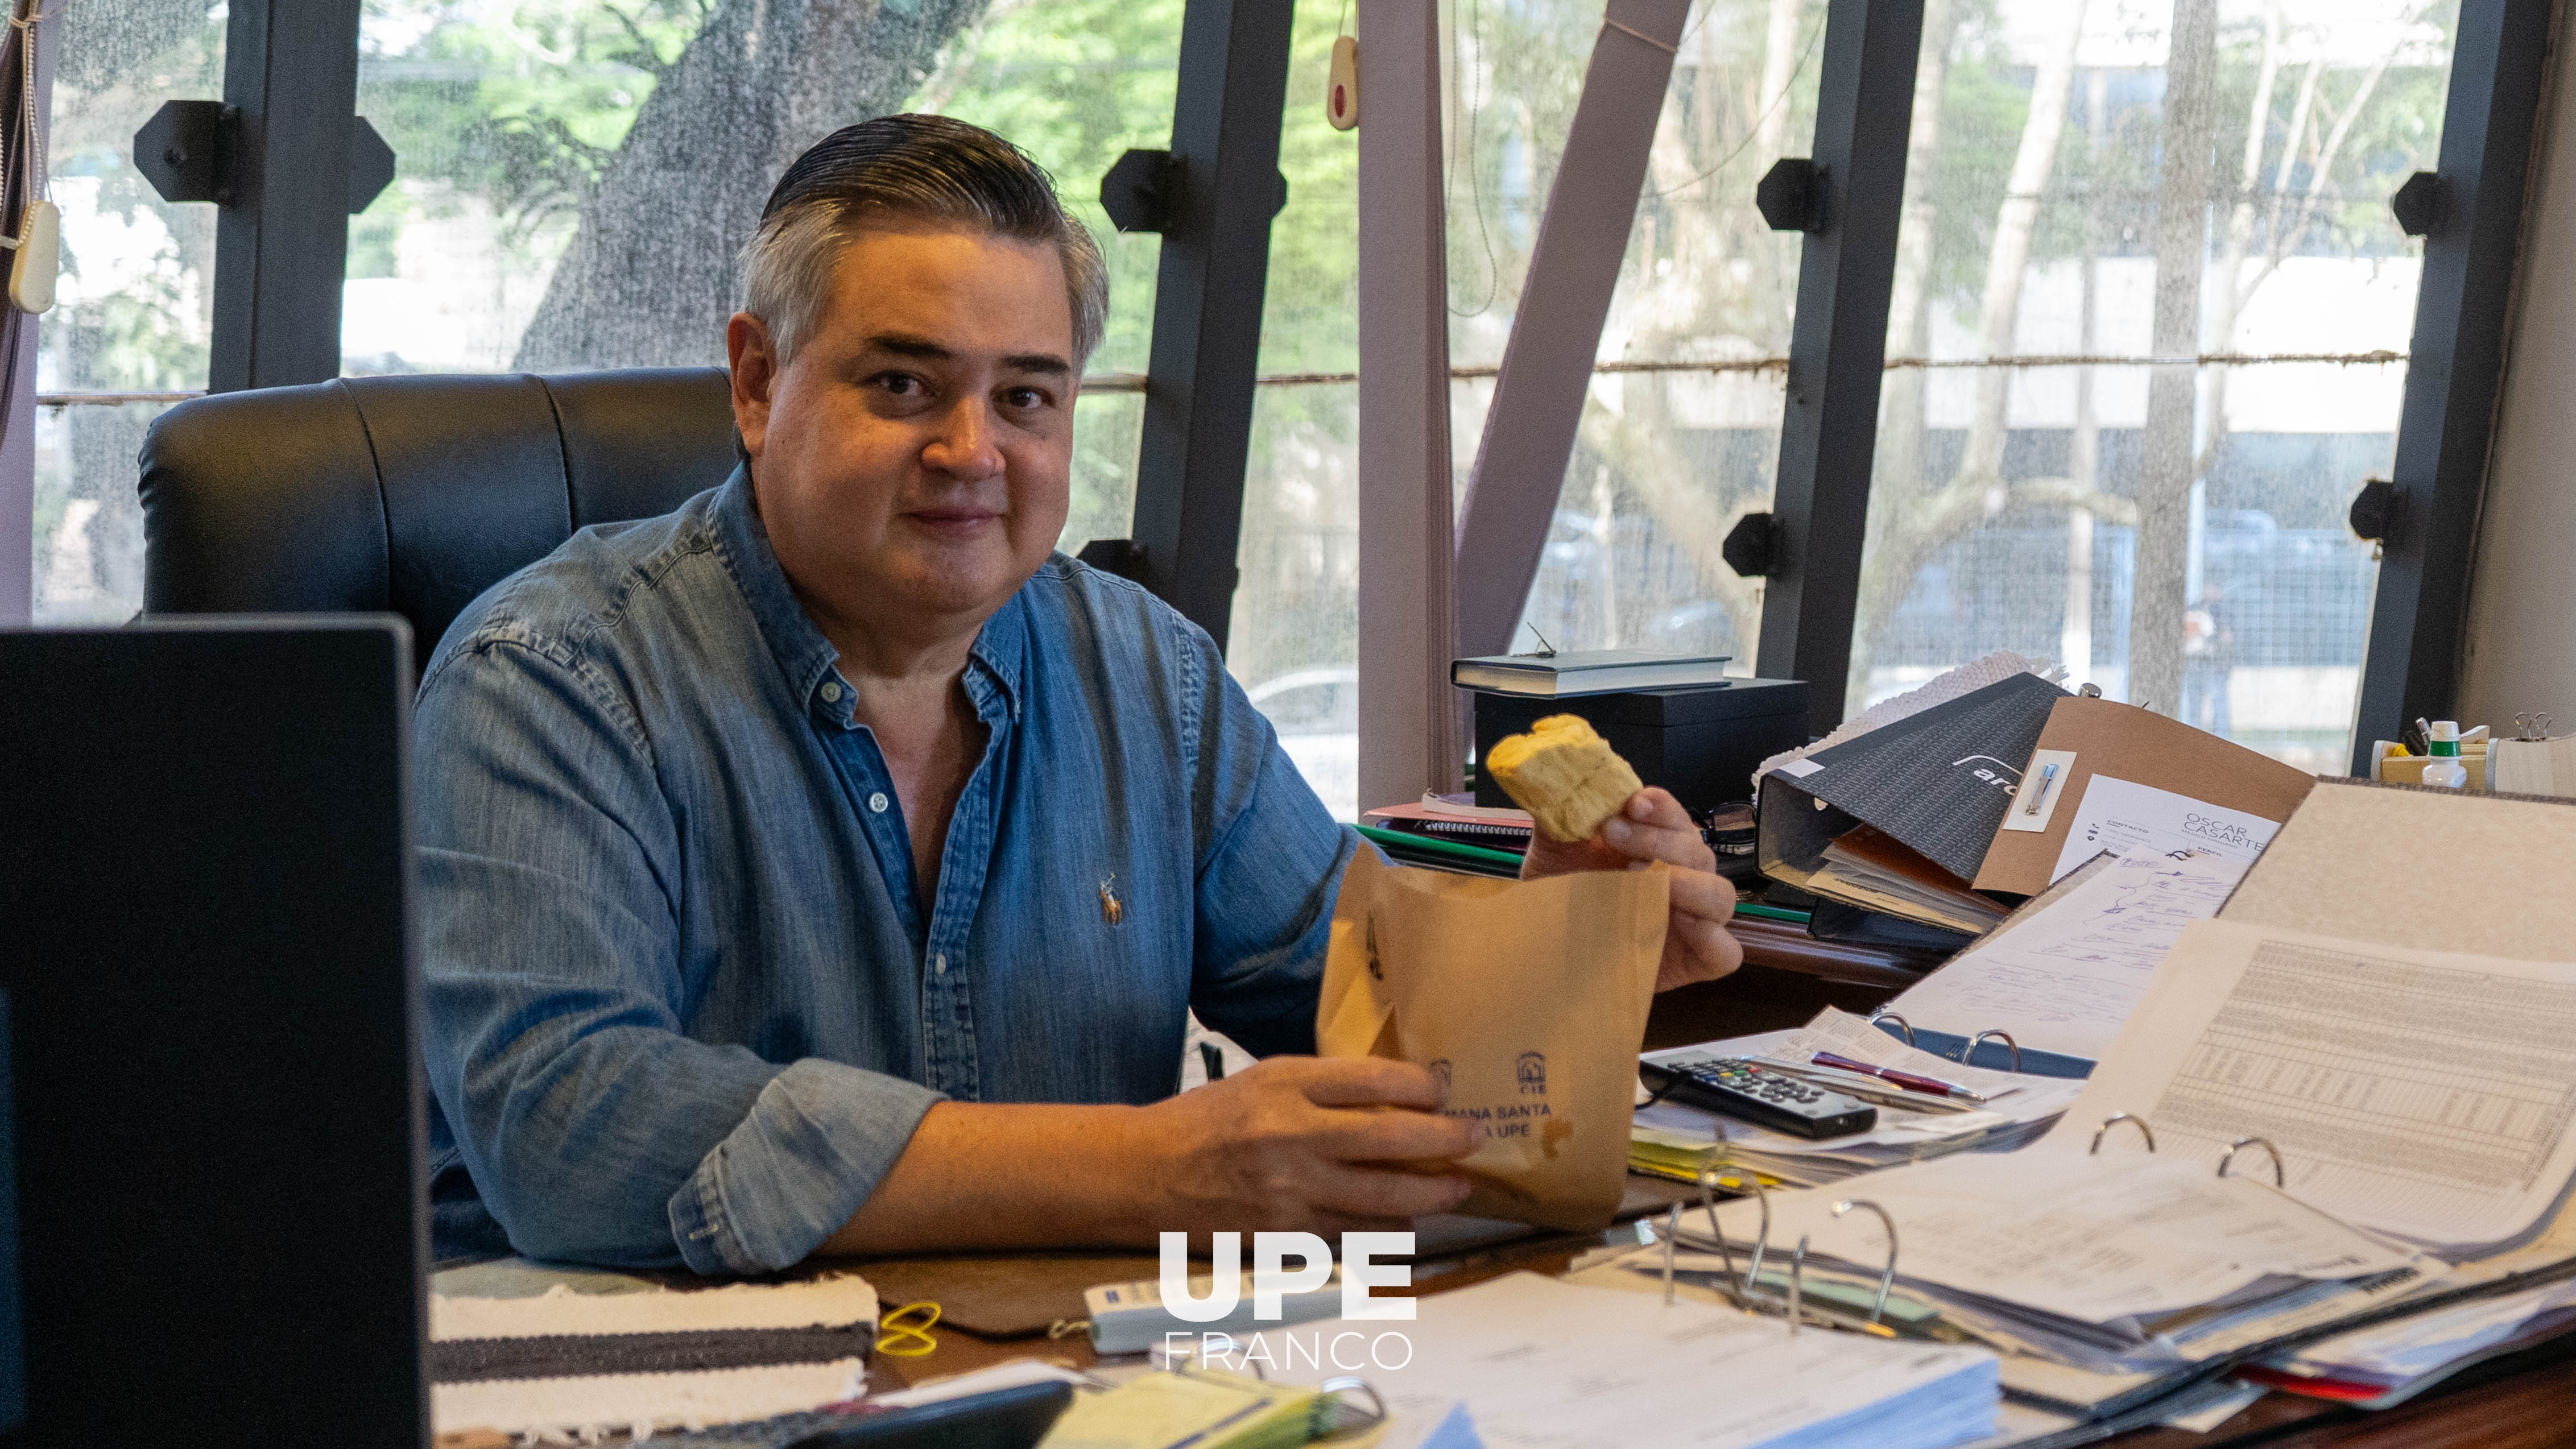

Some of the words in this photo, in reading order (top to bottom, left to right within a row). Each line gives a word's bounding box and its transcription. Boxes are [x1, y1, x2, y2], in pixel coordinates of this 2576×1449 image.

[2107, 819, 2149, 834] CONTACTO
[2186, 813, 2247, 838] OSCAR
[2197, 846, 2223, 857] PERFIL
[1442, 1107, 1492, 1120] MANA
[1497, 1103, 1551, 1119] SANTA
[1497, 1123, 1530, 1138] UPE
